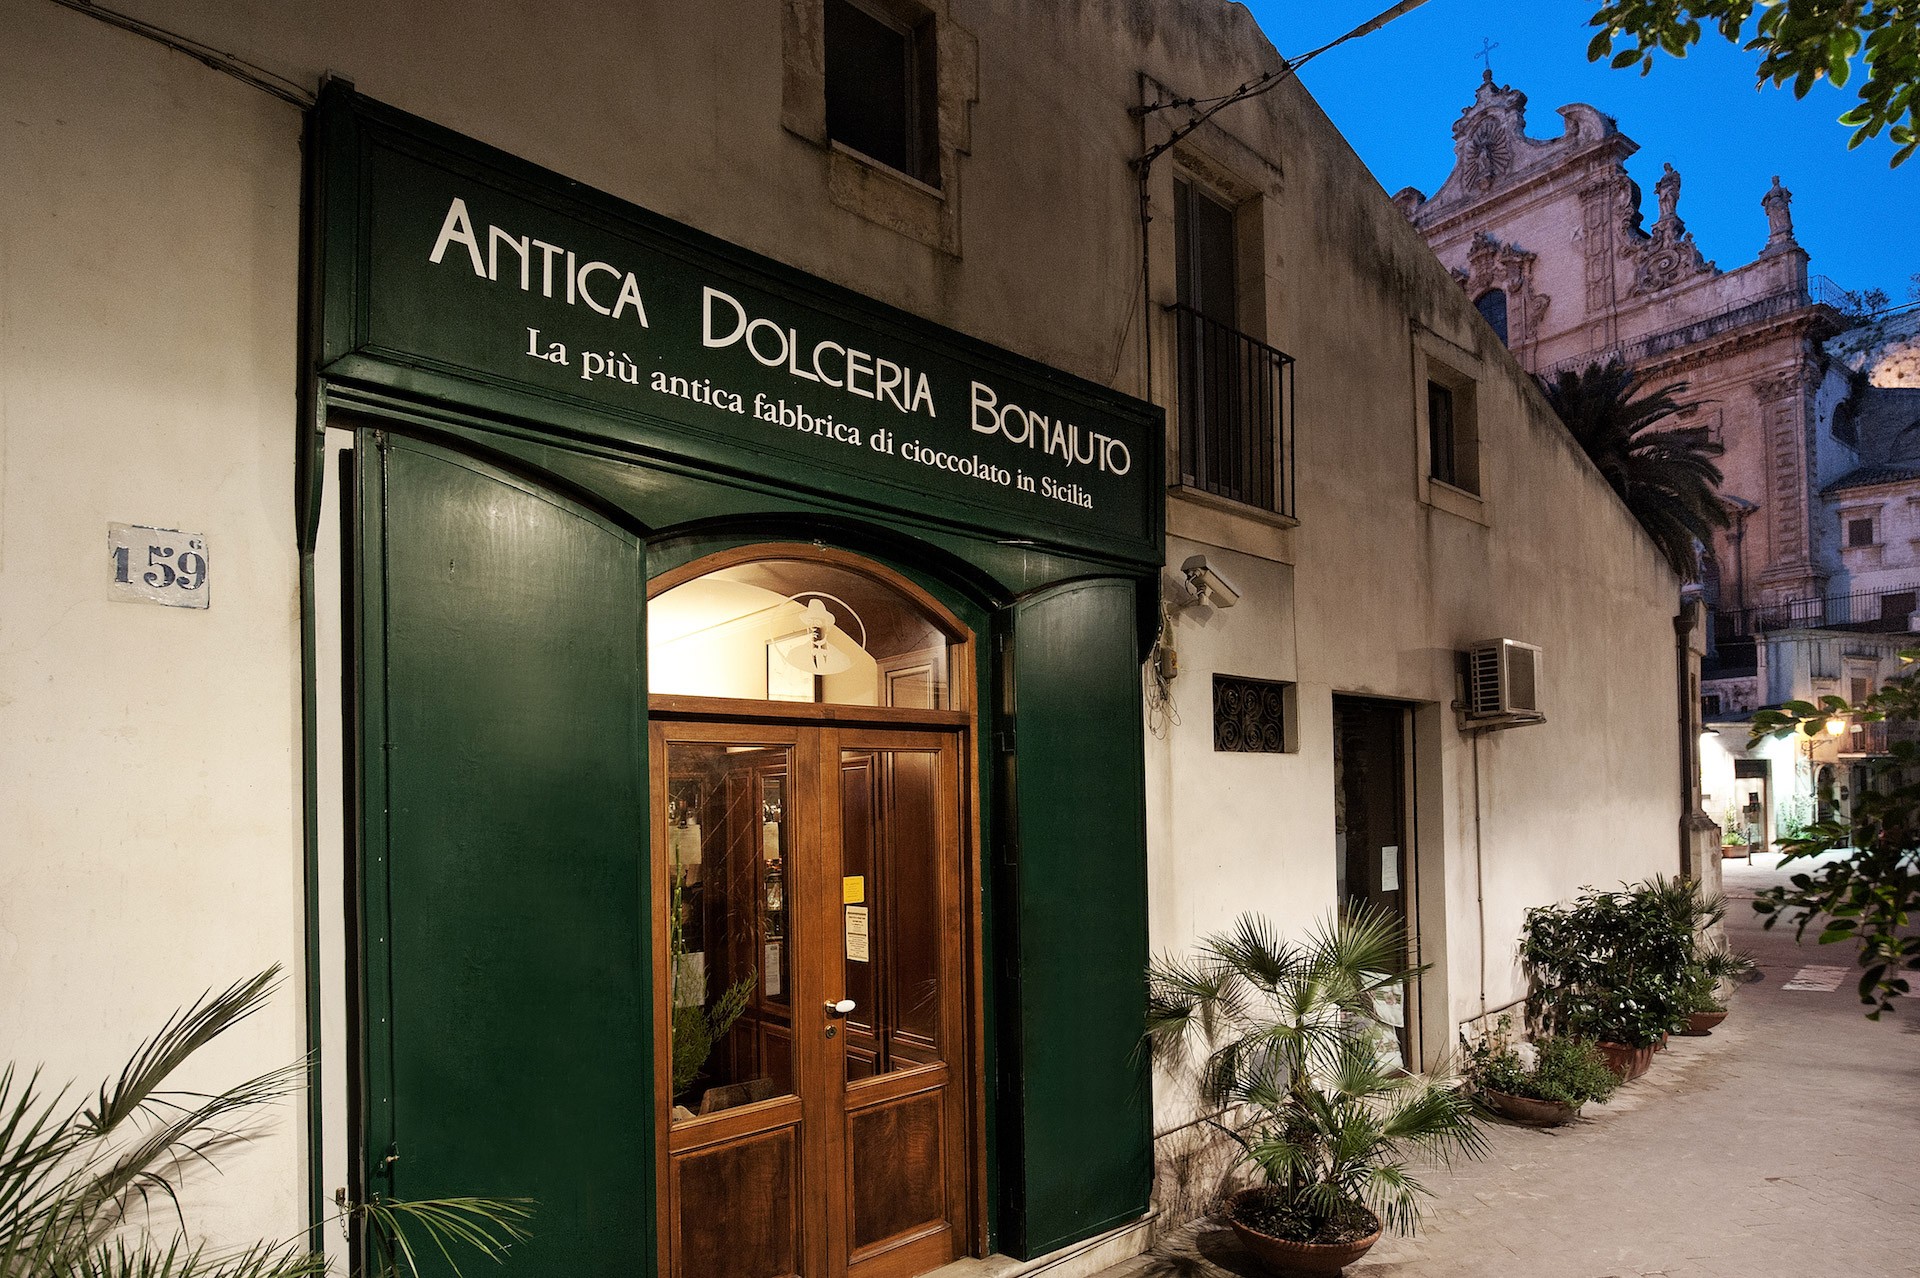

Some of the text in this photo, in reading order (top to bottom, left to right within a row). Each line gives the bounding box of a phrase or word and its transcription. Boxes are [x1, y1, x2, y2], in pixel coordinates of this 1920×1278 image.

[429, 197, 1131, 476] ANTICA DOLCERIA BONAJUTO
[526, 327, 1094, 510] La più antica fabbrica di cioccolato in Sicilia
[112, 545, 206, 591] 159
